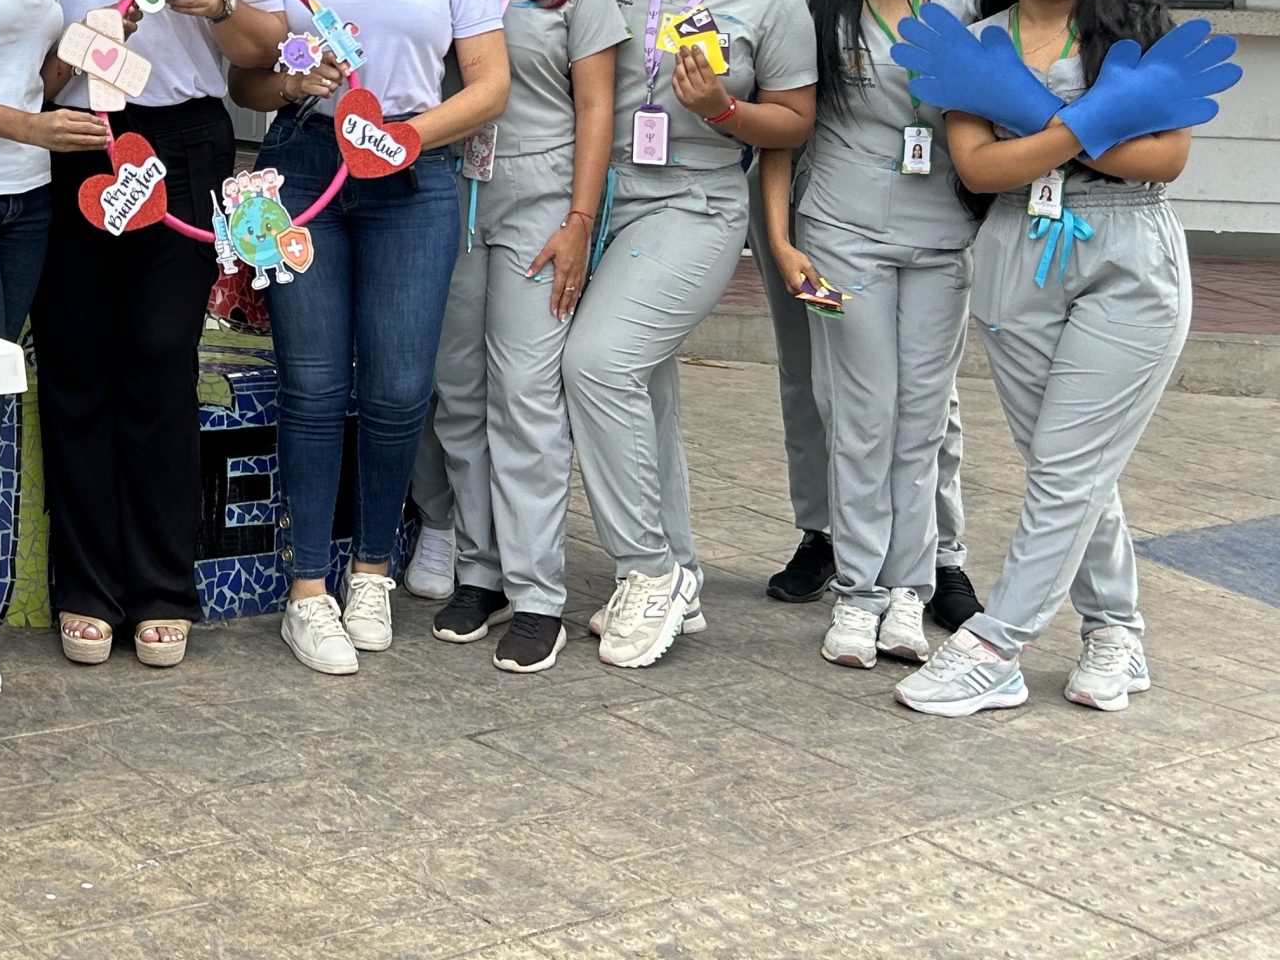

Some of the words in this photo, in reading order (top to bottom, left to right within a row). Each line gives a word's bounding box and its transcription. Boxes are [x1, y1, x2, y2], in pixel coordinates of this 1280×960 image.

[345, 117, 357, 135] y
[355, 123, 403, 162] Salud
[103, 188, 127, 207] Por
[120, 167, 138, 189] mi
[107, 162, 163, 231] Bienestar
